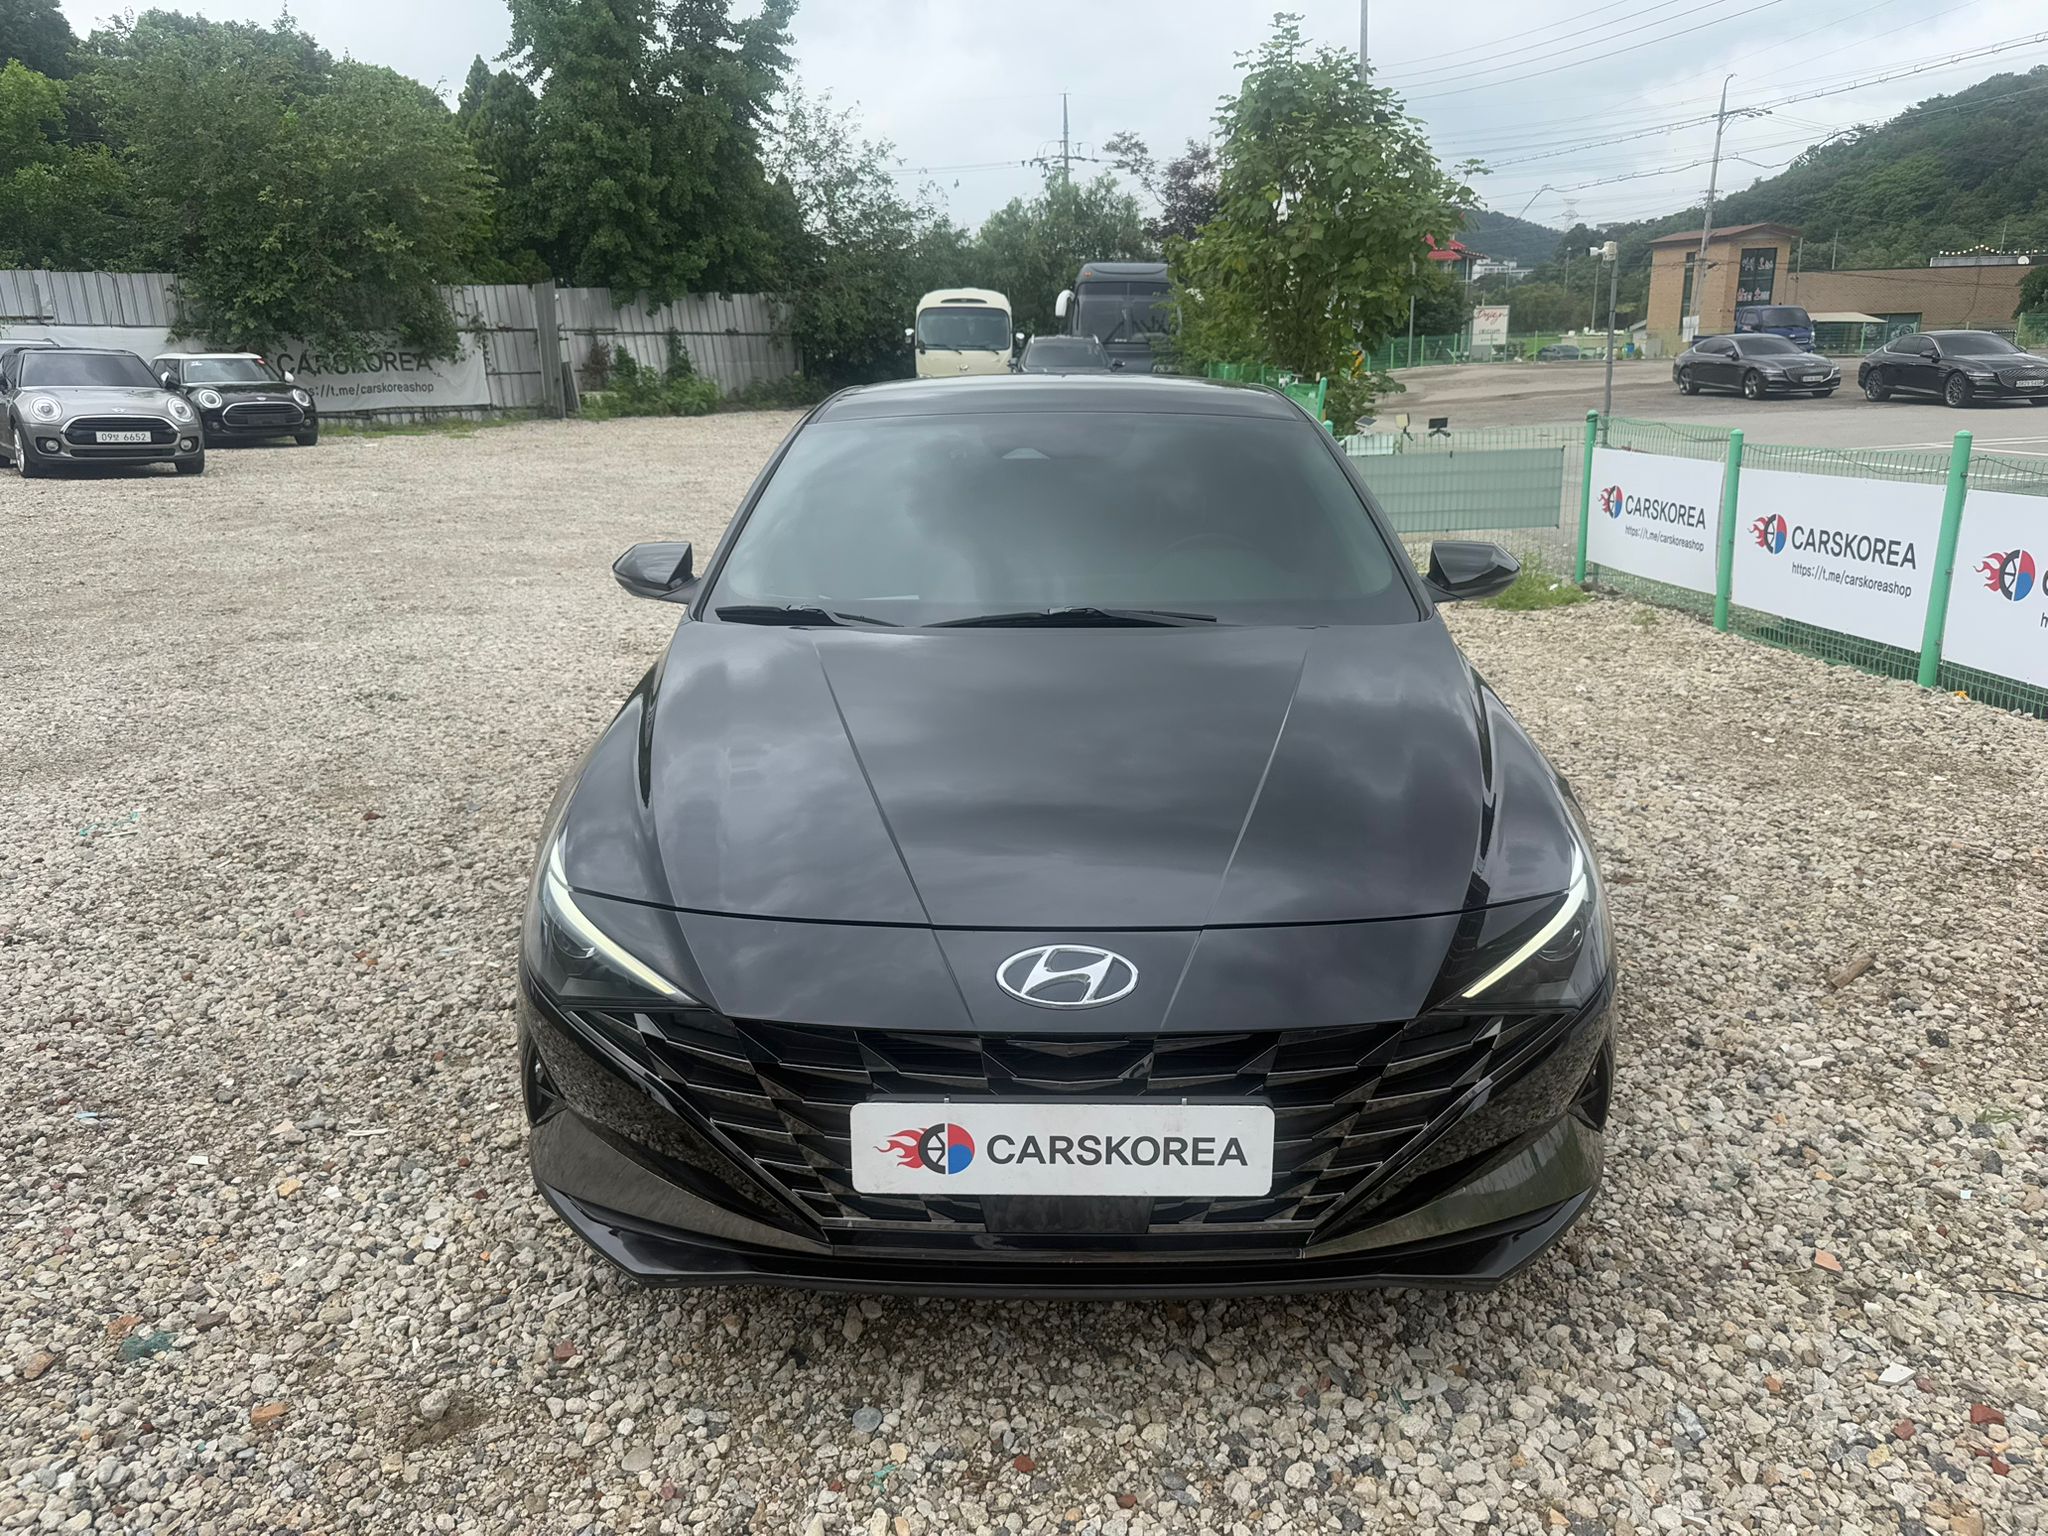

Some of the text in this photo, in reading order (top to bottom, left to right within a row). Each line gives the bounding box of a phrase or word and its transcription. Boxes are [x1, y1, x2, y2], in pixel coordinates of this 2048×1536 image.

[304, 382, 434, 398] s://t.me/carskoreashop
[123, 432, 147, 442] 6652
[1625, 494, 1706, 530] CARSKOREA
[1625, 524, 1705, 552] https://t.me/carskoreashop
[1791, 525, 1917, 570] CARSKOREA
[1791, 561, 1912, 598] https://t.me/carskoreashop
[986, 1134, 1249, 1167] CARSKOREA
